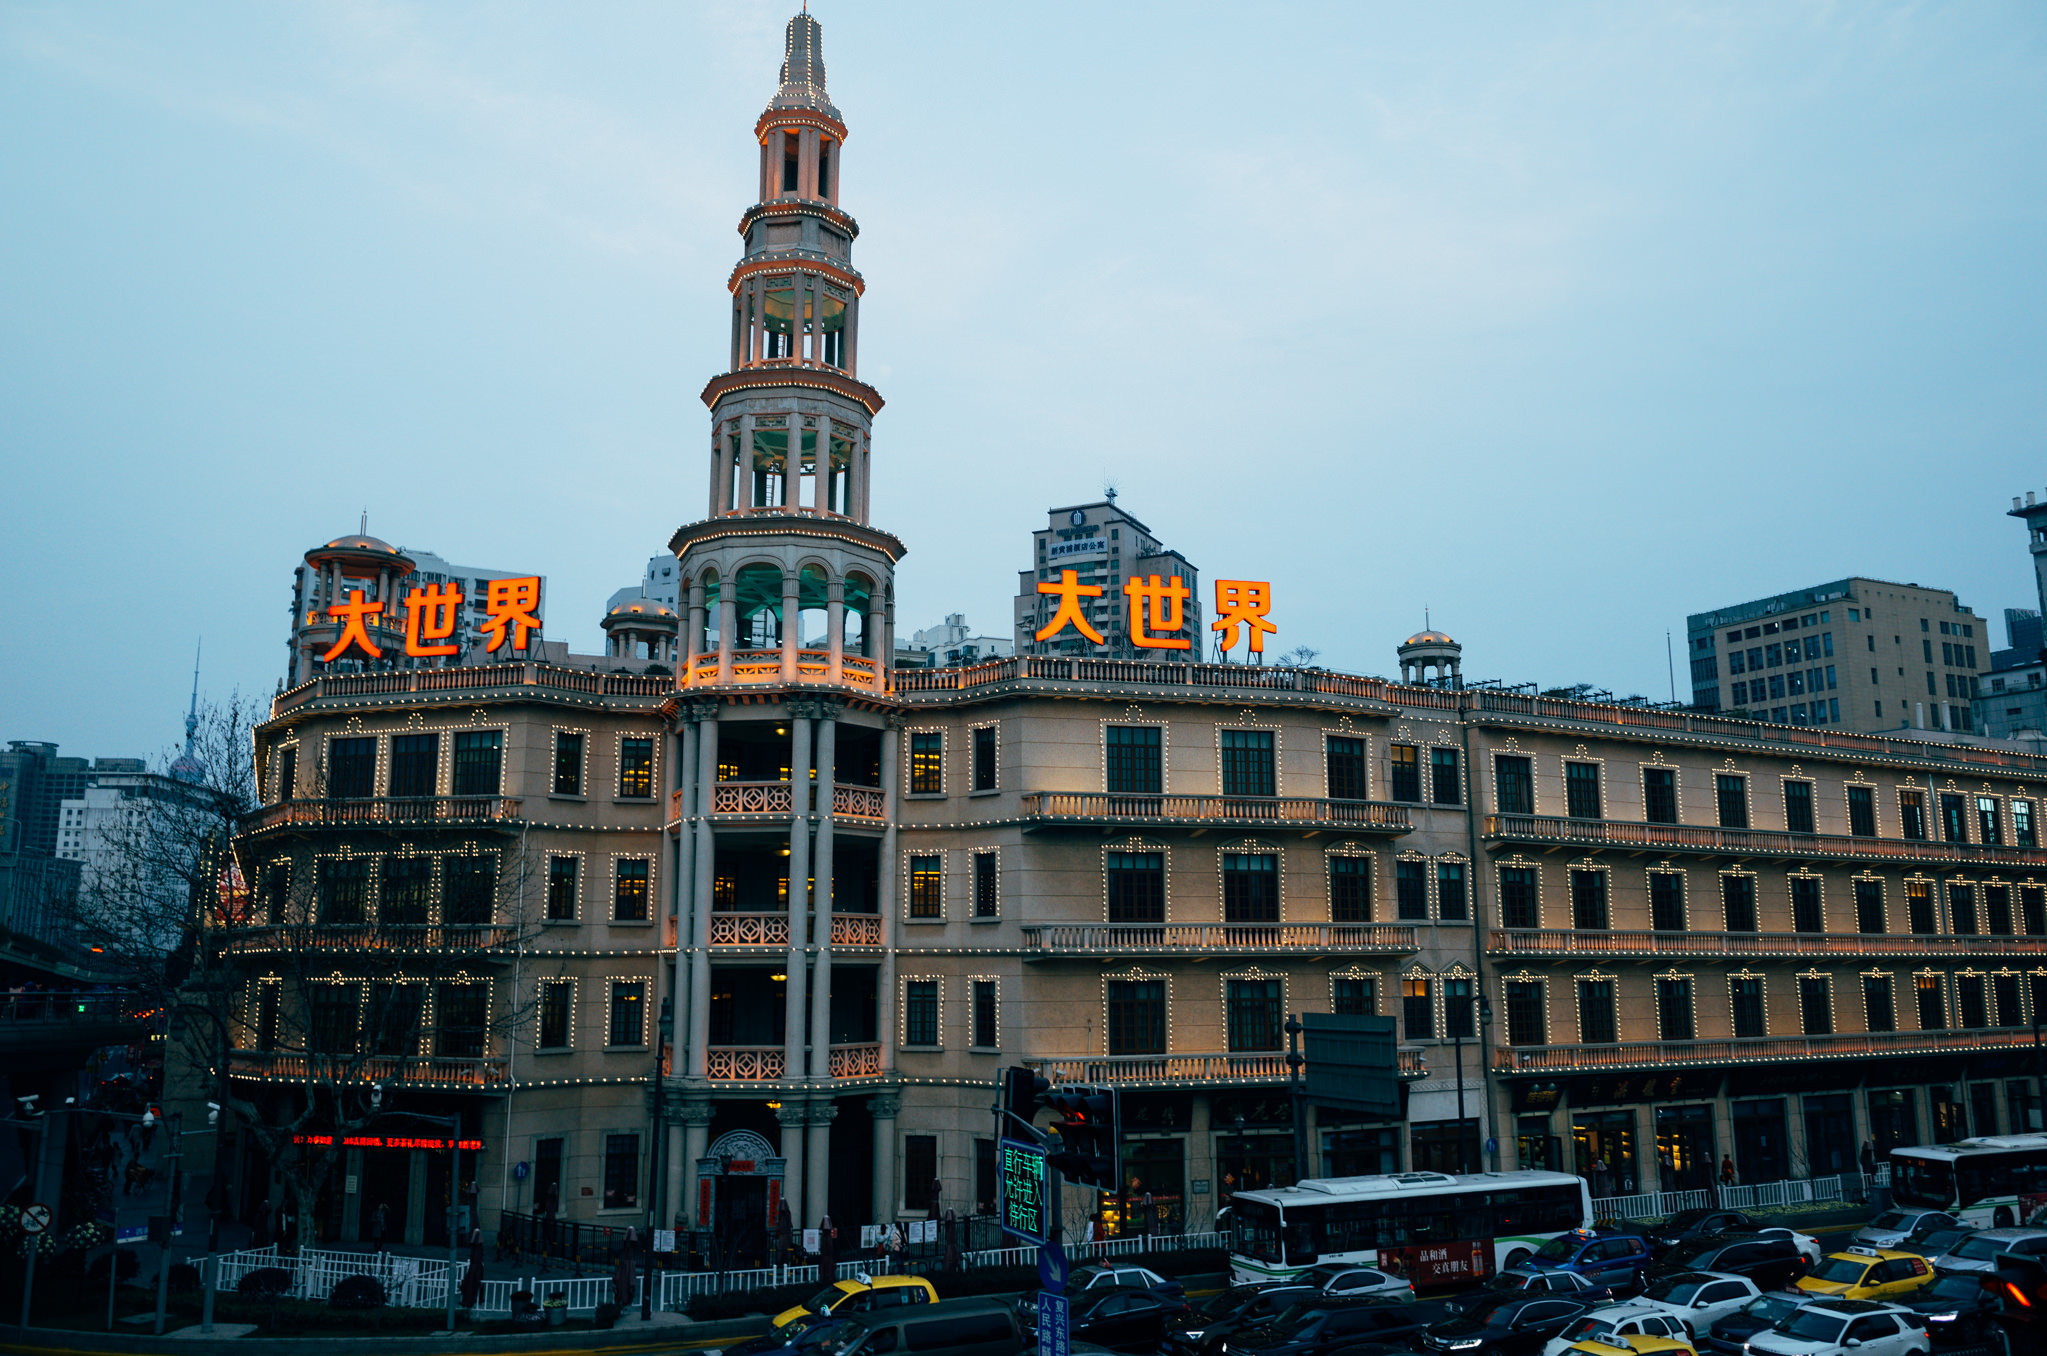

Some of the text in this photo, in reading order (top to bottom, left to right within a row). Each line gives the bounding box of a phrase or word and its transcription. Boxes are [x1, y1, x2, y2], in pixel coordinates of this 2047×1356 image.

[324, 576, 543, 663] 大世界
[1036, 570, 1277, 652] 大世界
[1004, 1147, 1043, 1181] 直行车辆
[1004, 1172, 1043, 1206] 允许进入
[1008, 1200, 1038, 1232] 待行区
[1420, 1248, 1448, 1262] 品和酒
[1432, 1260, 1468, 1275] 交真朋友
[1055, 1300, 1065, 1356] 复兴东路
